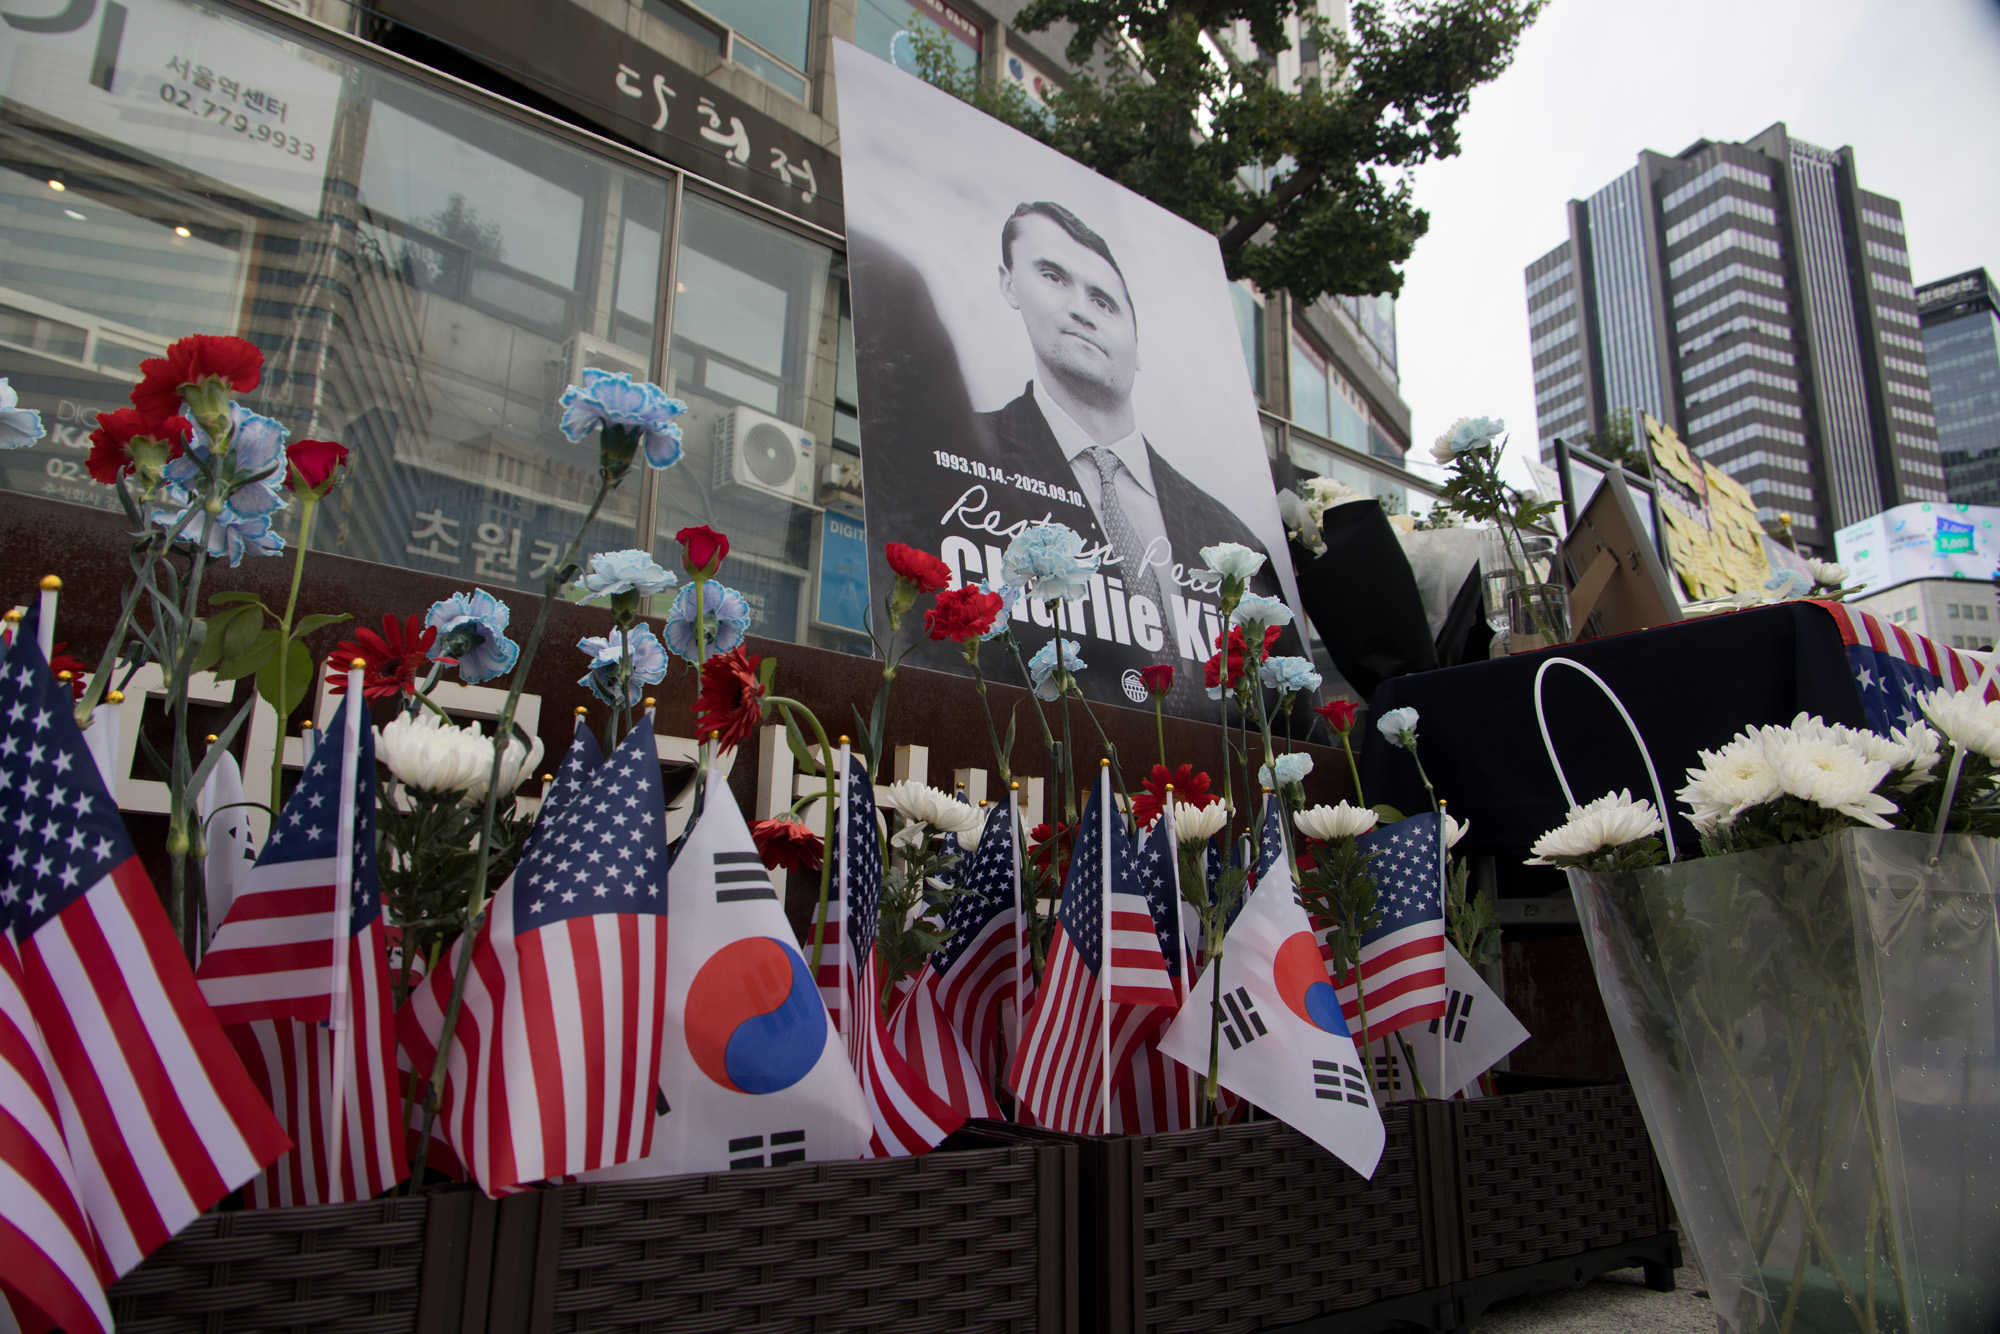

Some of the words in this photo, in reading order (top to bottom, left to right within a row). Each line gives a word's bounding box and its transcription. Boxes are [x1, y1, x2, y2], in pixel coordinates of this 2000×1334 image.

[159, 82, 315, 162] 02.779.9933
[165, 54, 288, 122] 서울역센터
[933, 450, 1086, 508] 1993.10.14.~2025.09.10.
[406, 508, 593, 584] 초원카
[830, 520, 867, 543] DIGIT
[1170, 594, 1226, 664] Ki
